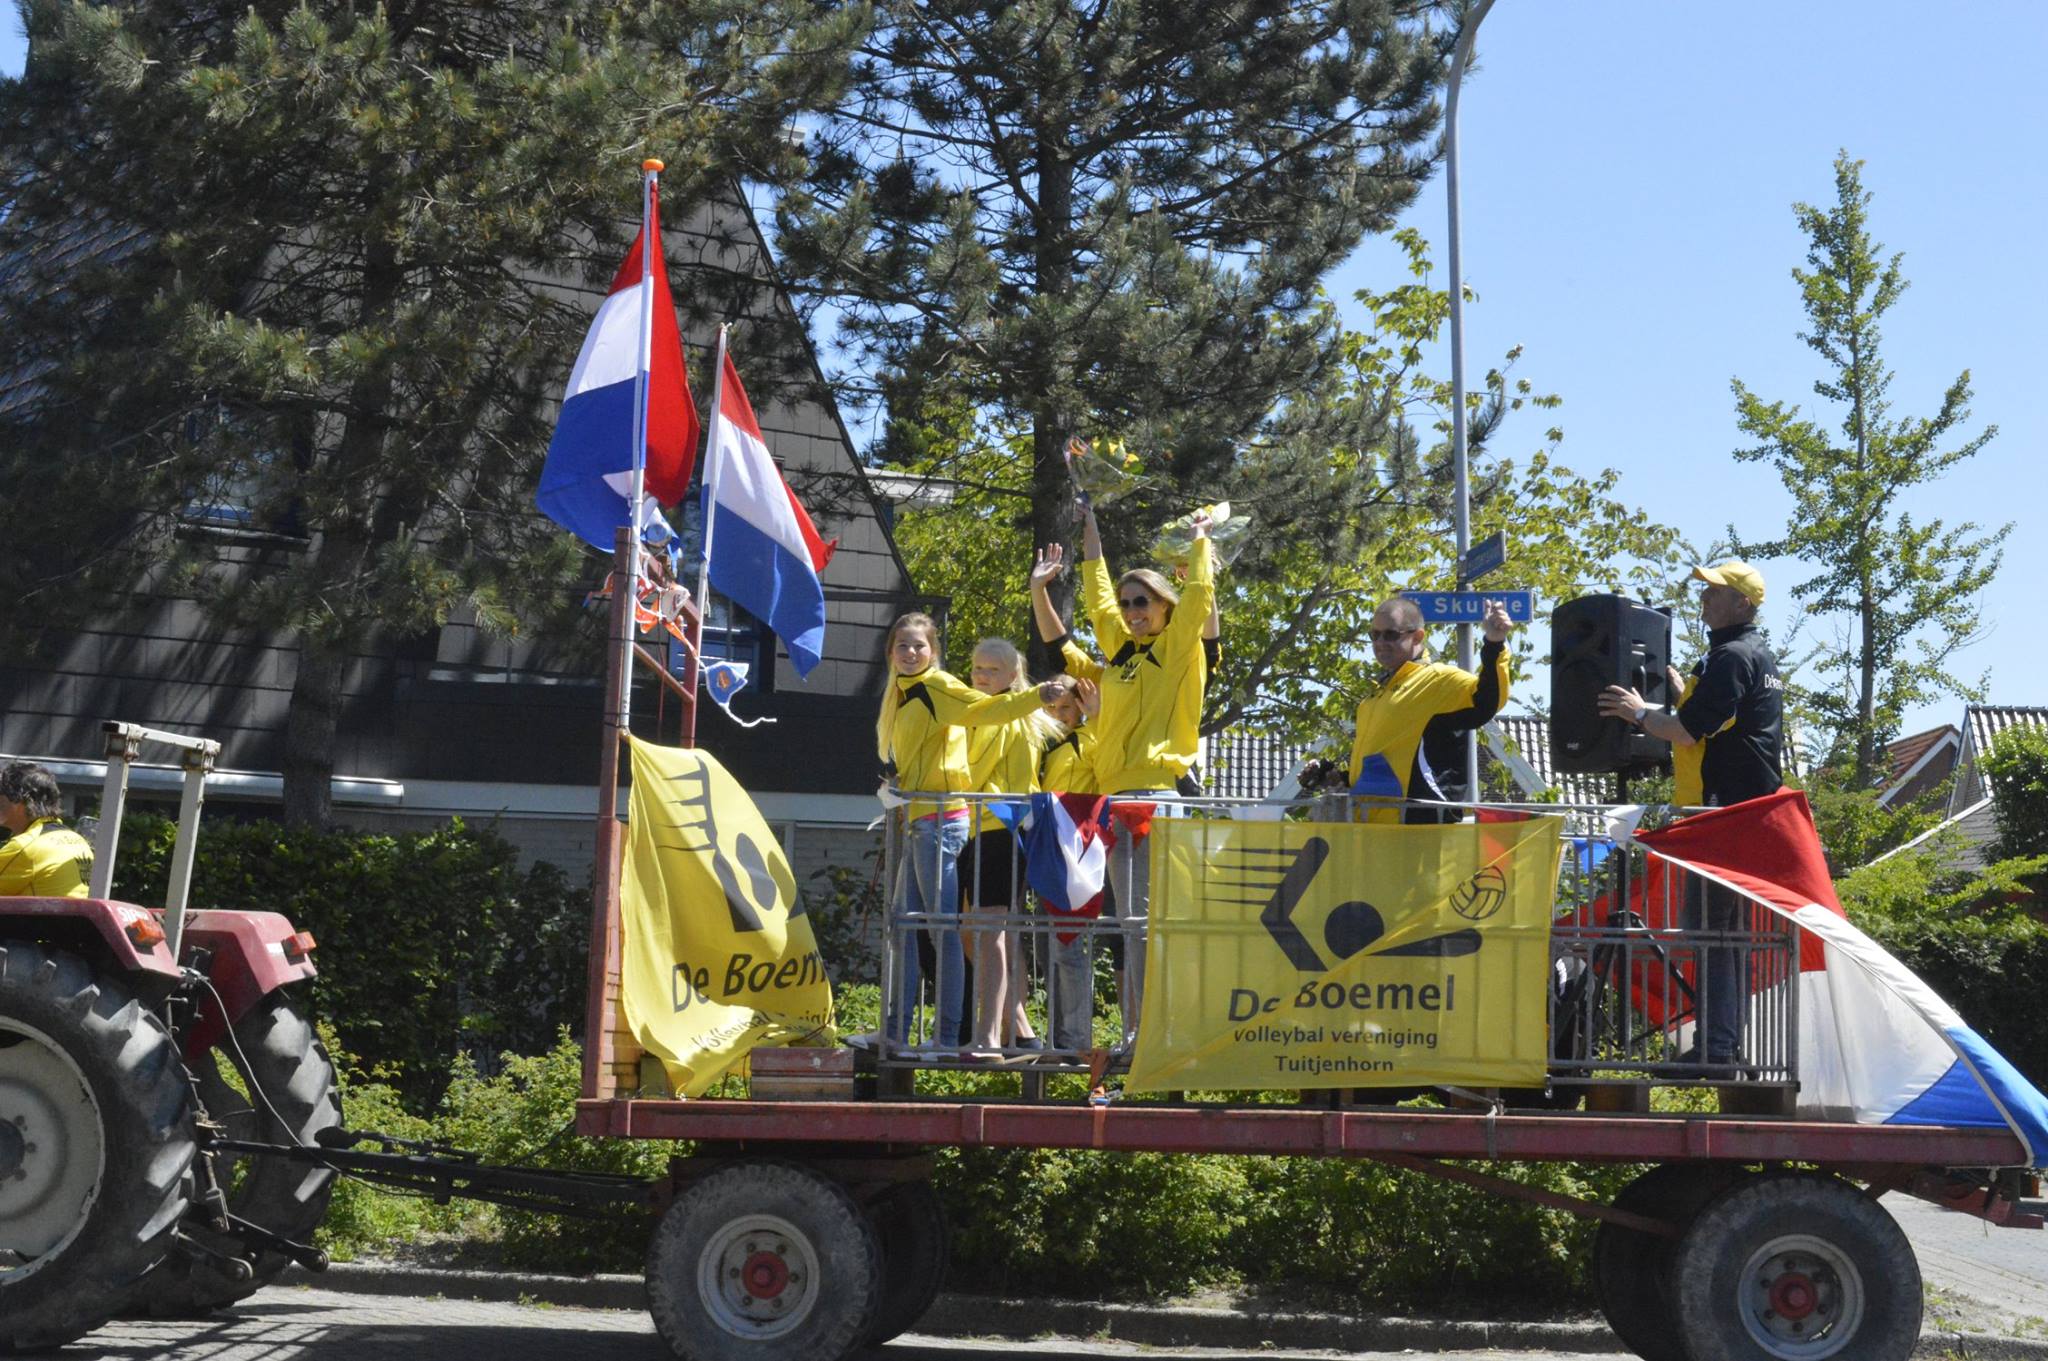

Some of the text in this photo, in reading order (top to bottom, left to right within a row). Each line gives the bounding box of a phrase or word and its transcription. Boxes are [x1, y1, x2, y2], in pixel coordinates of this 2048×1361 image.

[1434, 596, 1523, 614] Skuije
[671, 961, 709, 1014] De
[1293, 973, 1455, 1011] Boemel
[1331, 1028, 1438, 1048] vereniging
[1274, 1055, 1394, 1075] Tuitjenhorn
